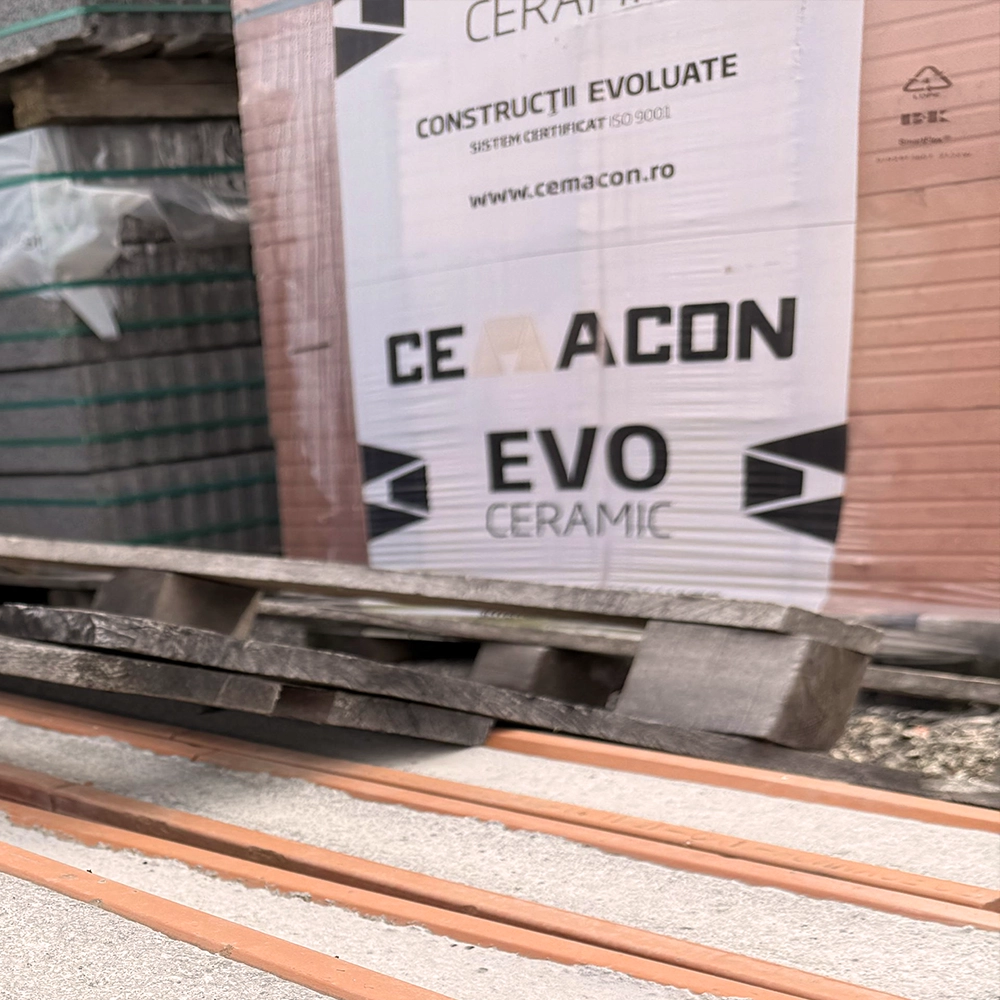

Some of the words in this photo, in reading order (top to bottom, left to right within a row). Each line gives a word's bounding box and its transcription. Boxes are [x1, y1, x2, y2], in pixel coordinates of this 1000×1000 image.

[587, 53, 738, 103] EVOLUATE
[469, 133, 520, 154] SISTEM
[523, 117, 606, 143] CERTIFICAT
[608, 111, 633, 128] ISO
[634, 105, 672, 125] 9001
[469, 163, 675, 208] www.cemacon.ro
[485, 424, 670, 493] EVO
[484, 500, 672, 539] CERAMIC
